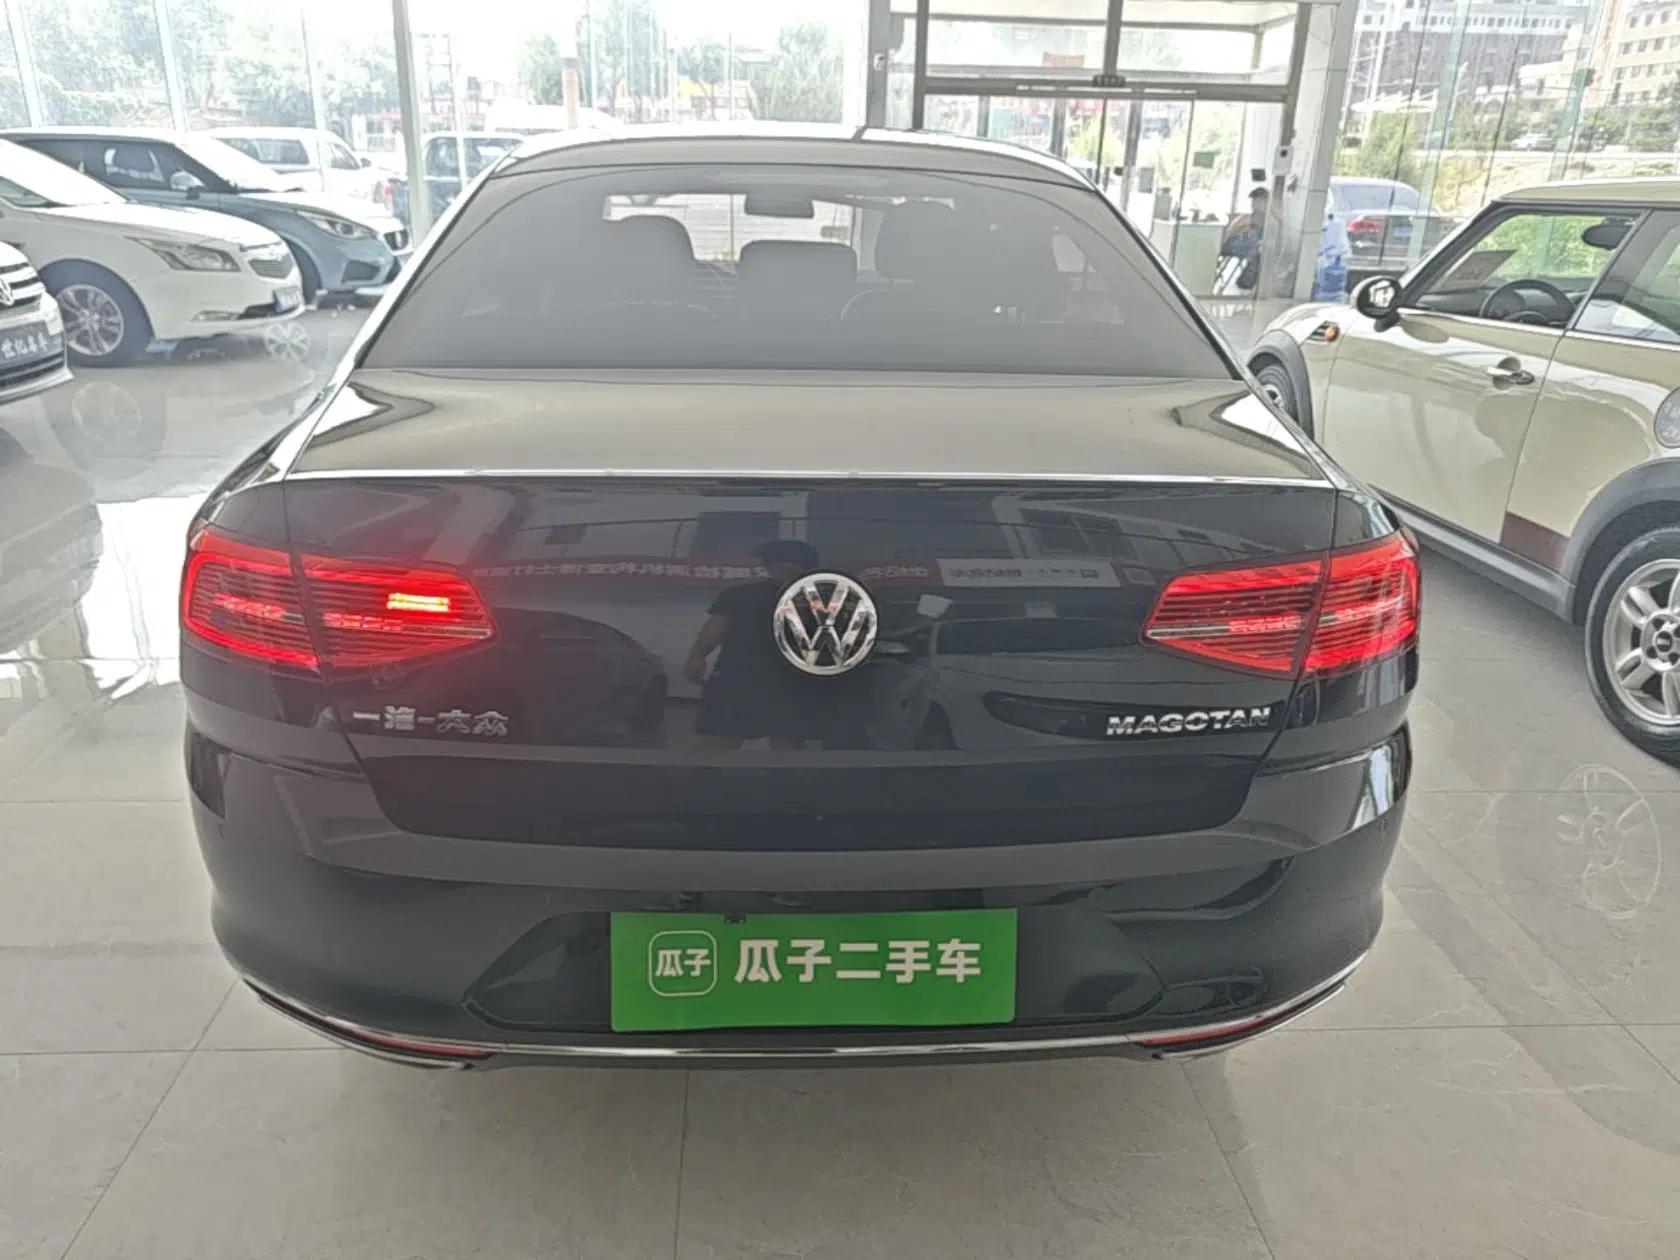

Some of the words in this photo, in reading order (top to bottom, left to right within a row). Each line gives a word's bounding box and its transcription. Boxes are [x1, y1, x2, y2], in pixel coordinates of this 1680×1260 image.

[1106, 707, 1271, 735] MAGOTAN
[655, 948, 712, 977] 瓜子
[733, 938, 982, 983] 瓜子二手车
